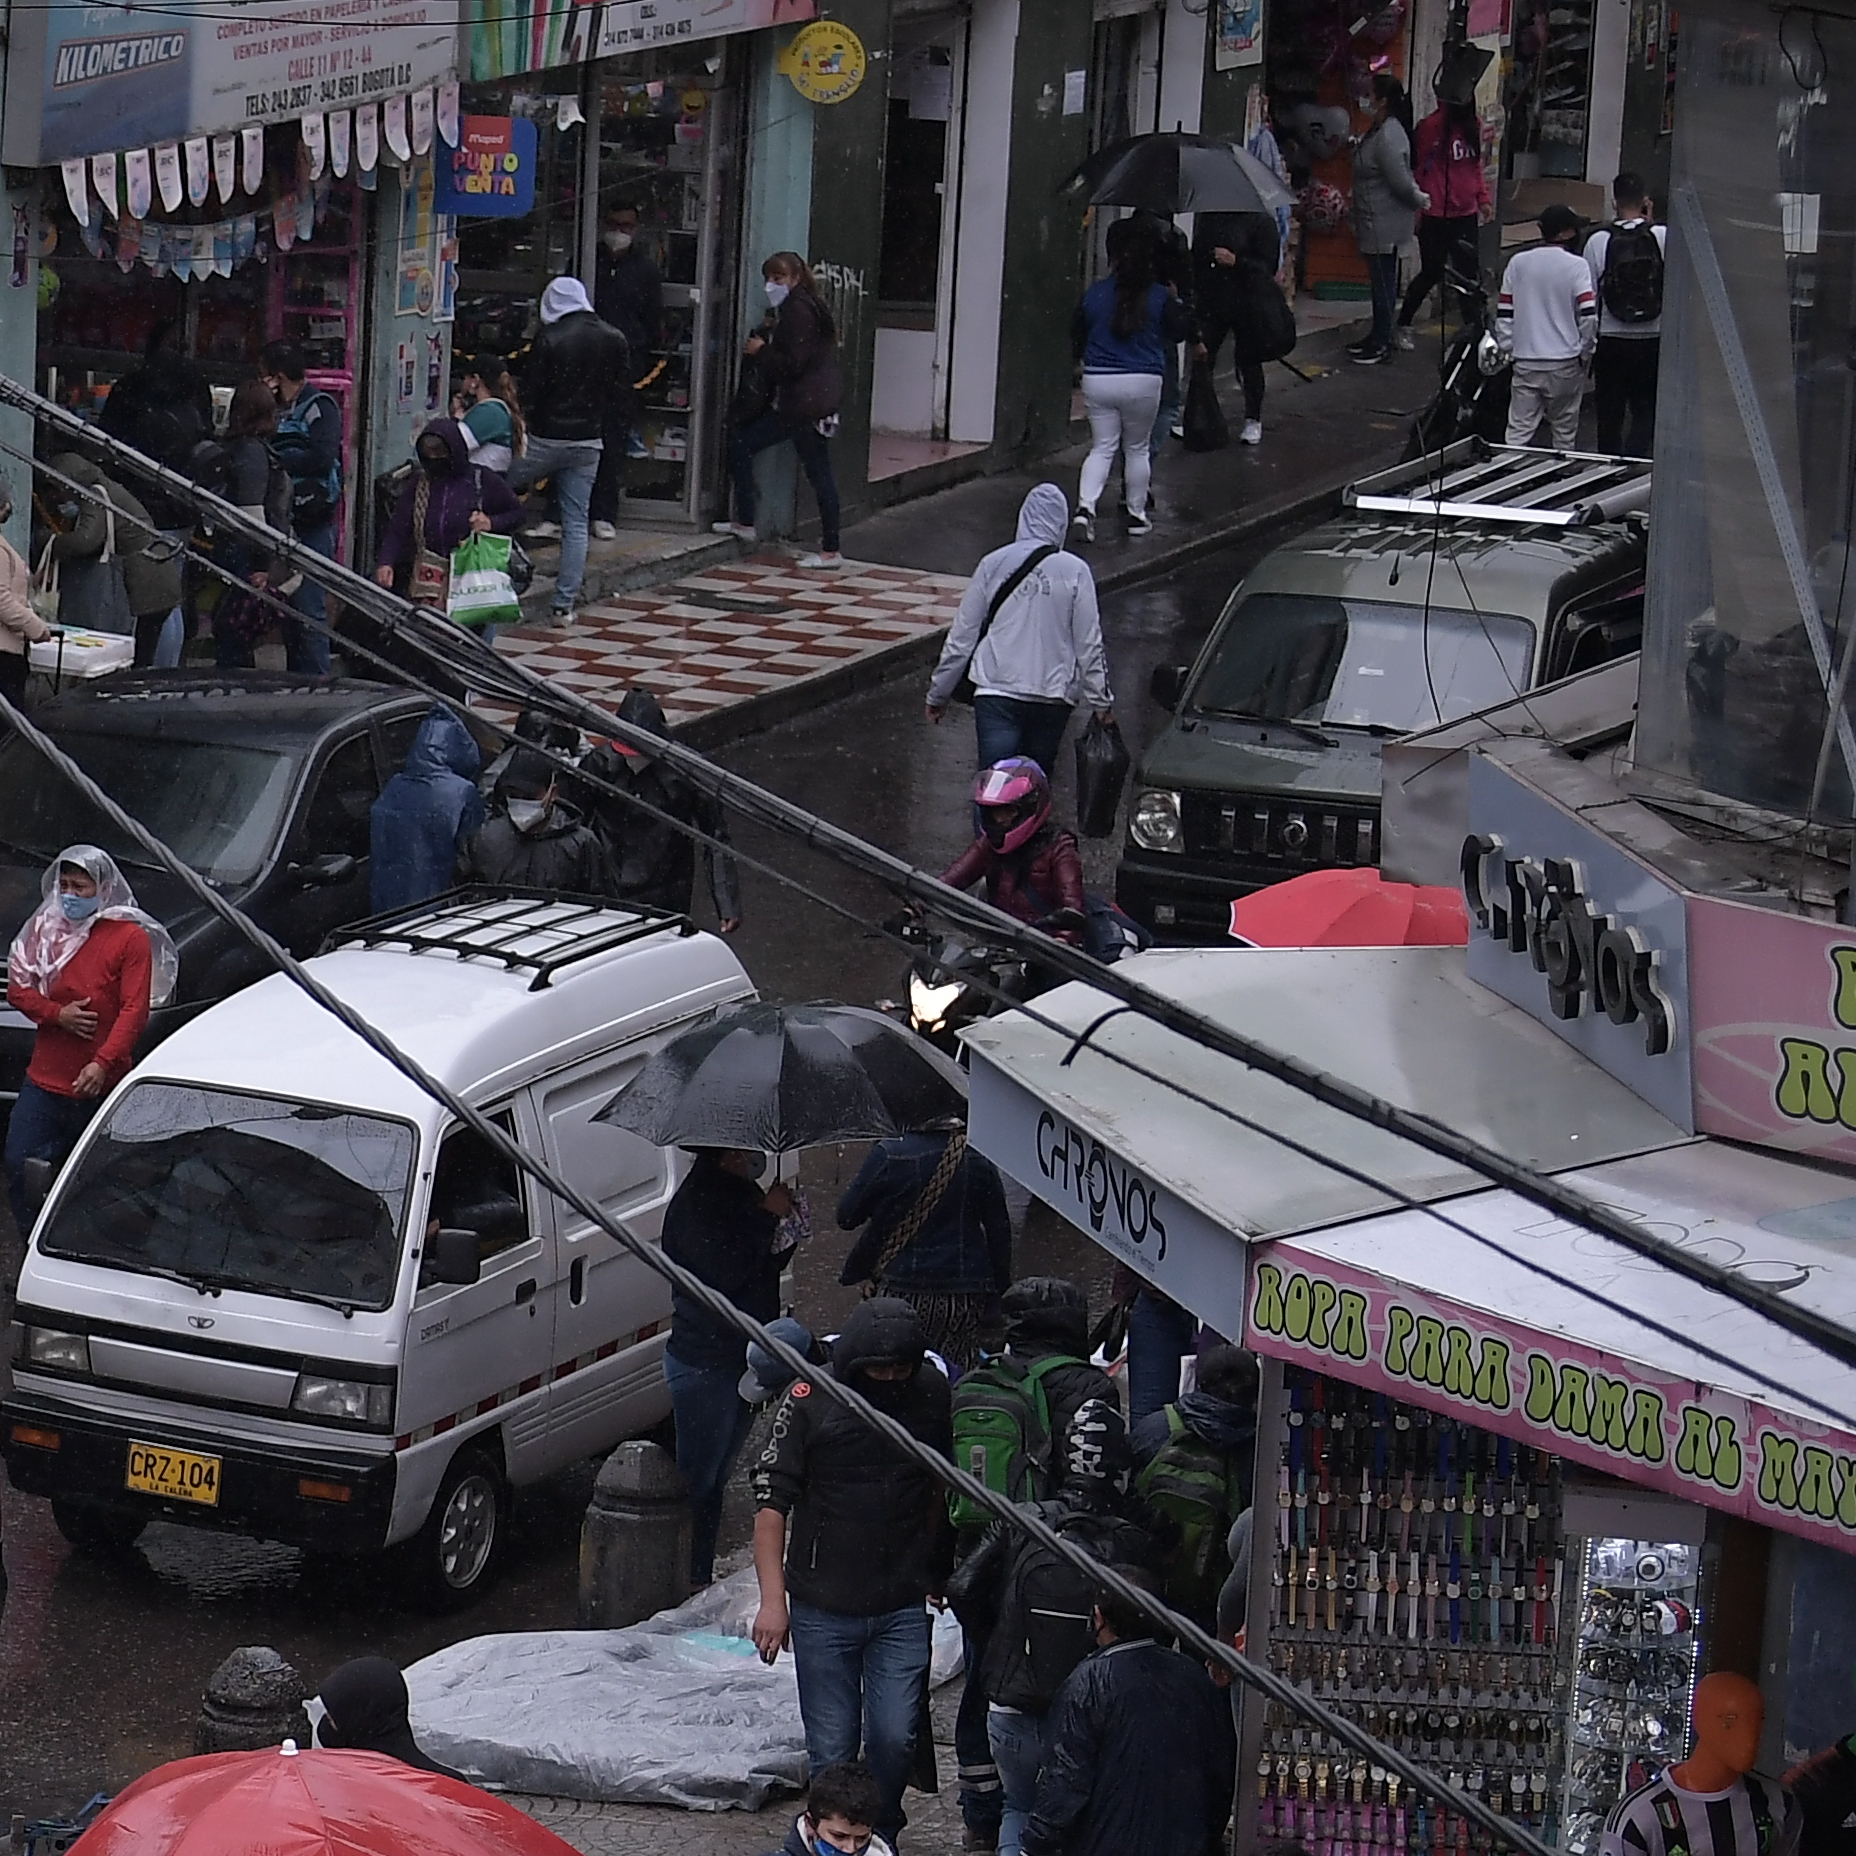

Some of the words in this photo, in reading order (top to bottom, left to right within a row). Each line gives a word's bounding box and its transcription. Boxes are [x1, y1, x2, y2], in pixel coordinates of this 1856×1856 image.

[217, 20, 266, 40] COMPLETO
[233, 40, 269, 60] VENTAS
[271, 37, 289, 54] POR
[291, 31, 323, 49] MAYOR
[288, 56, 315, 82] CALLE
[452, 150, 518, 173] PUNTO
[453, 174, 516, 195] VENTA
[1037, 1111, 1167, 1261] CHRONOS
[1253, 1263, 1368, 1361] ROPA
[1387, 1306, 1511, 1411] PARA
[1525, 1354, 1666, 1463] DAMA
[1676, 1406, 1743, 1490] AL
[761, 1394, 795, 1465] SPORT
